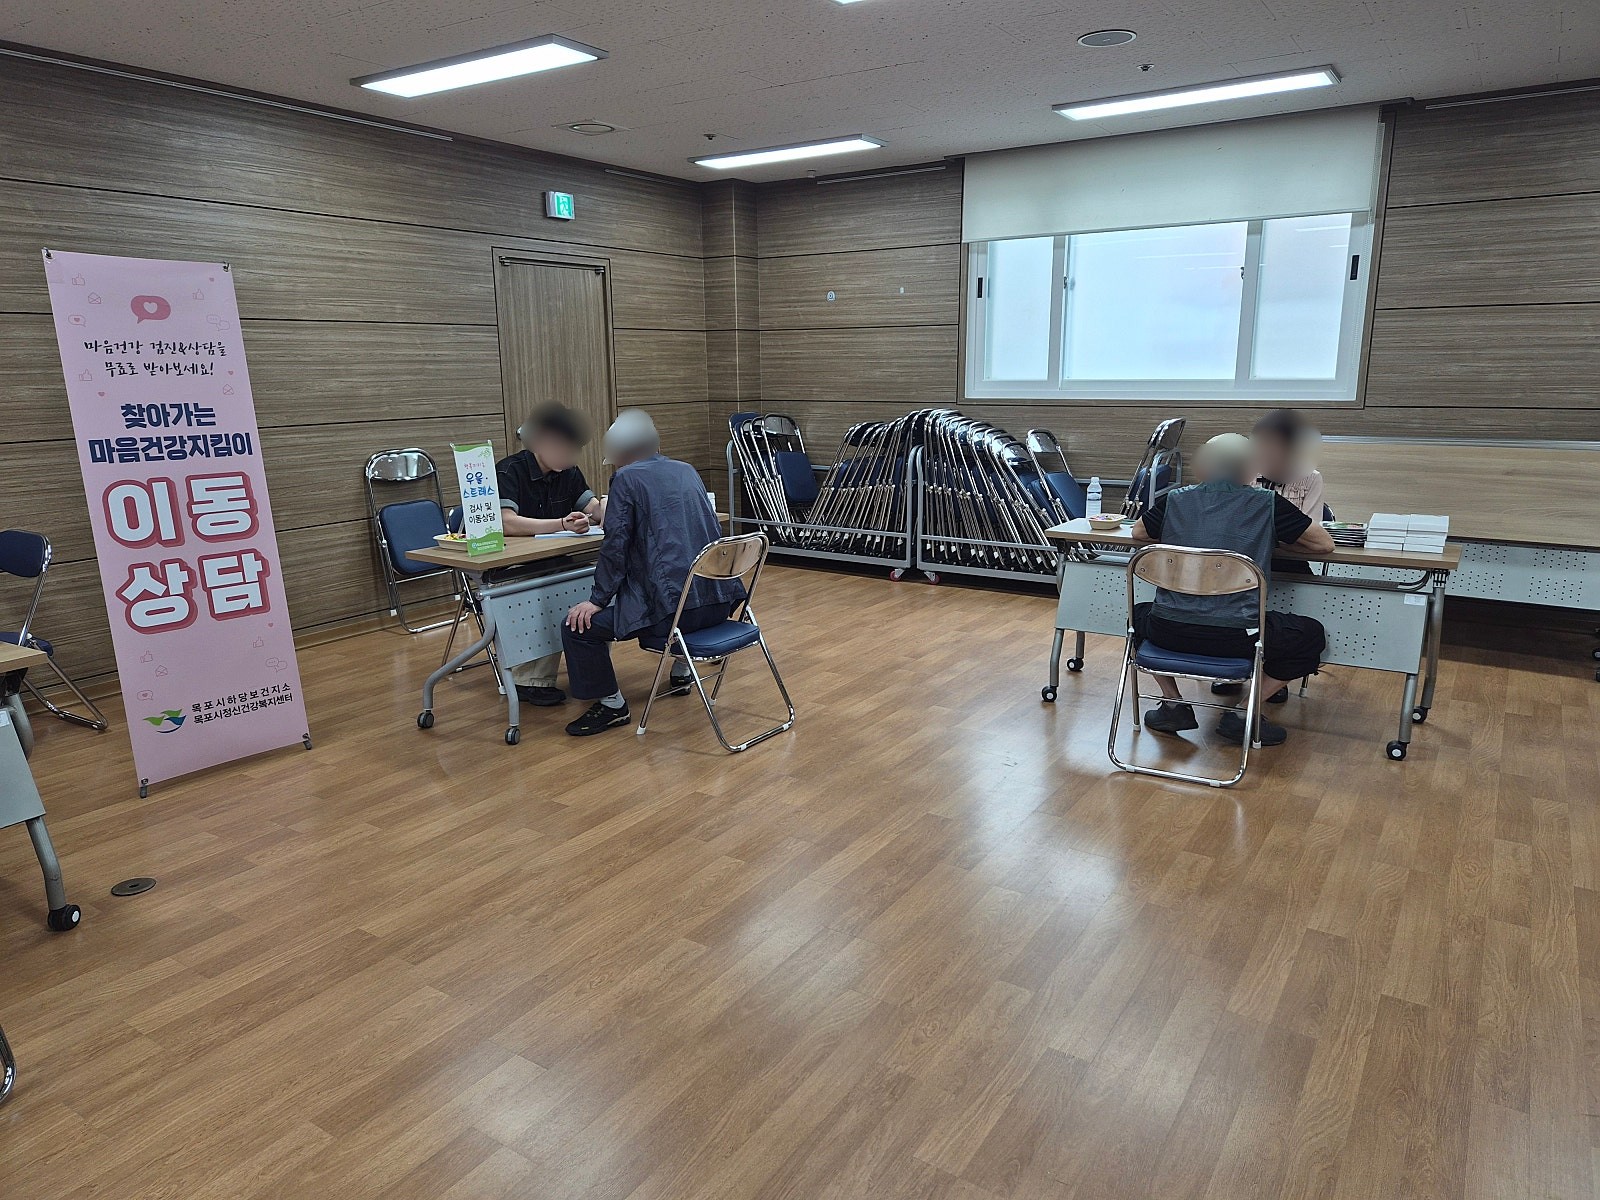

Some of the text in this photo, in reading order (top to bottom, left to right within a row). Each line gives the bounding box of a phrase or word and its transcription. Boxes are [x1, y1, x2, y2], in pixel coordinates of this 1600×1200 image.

[84, 340, 227, 357] 마음건강 검진&상담을
[105, 361, 214, 377] 무료로 받아보세요!
[120, 402, 217, 429] 찾아가는
[88, 432, 253, 464] 마음건강지킴이
[464, 486, 494, 498] 스트레스
[102, 471, 260, 549] 이동
[468, 513, 495, 524] 이동상담
[469, 501, 492, 513] 검사 및
[115, 548, 271, 635] 상담
[192, 683, 290, 712] 목포시하당보건지소
[194, 693, 293, 724] 목포시정신건강복지센터
